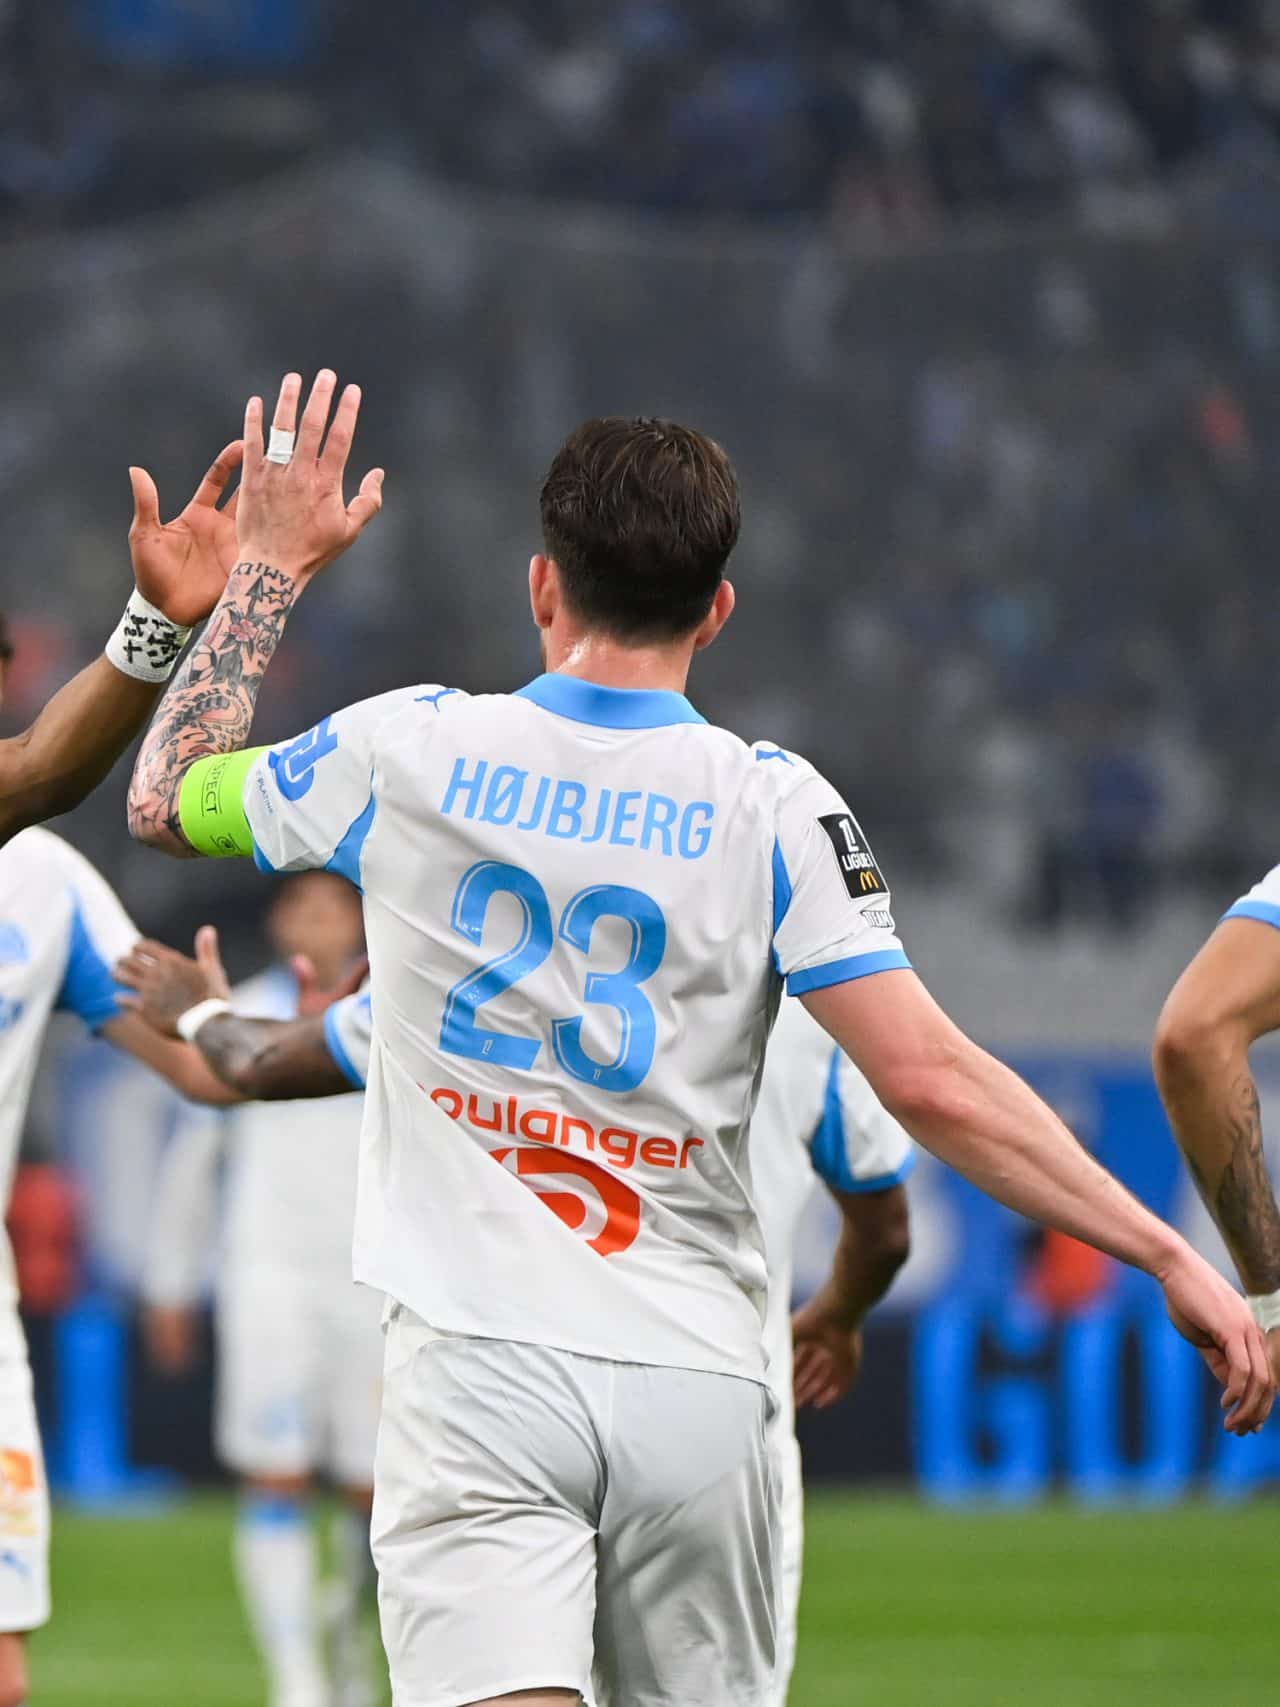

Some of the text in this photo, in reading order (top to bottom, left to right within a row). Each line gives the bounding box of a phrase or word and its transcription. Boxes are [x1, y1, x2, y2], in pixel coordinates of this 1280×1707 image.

[439, 757, 715, 860] HØJBJERG
[437, 859, 668, 1093] 23
[416, 1081, 705, 1170] oulanger
